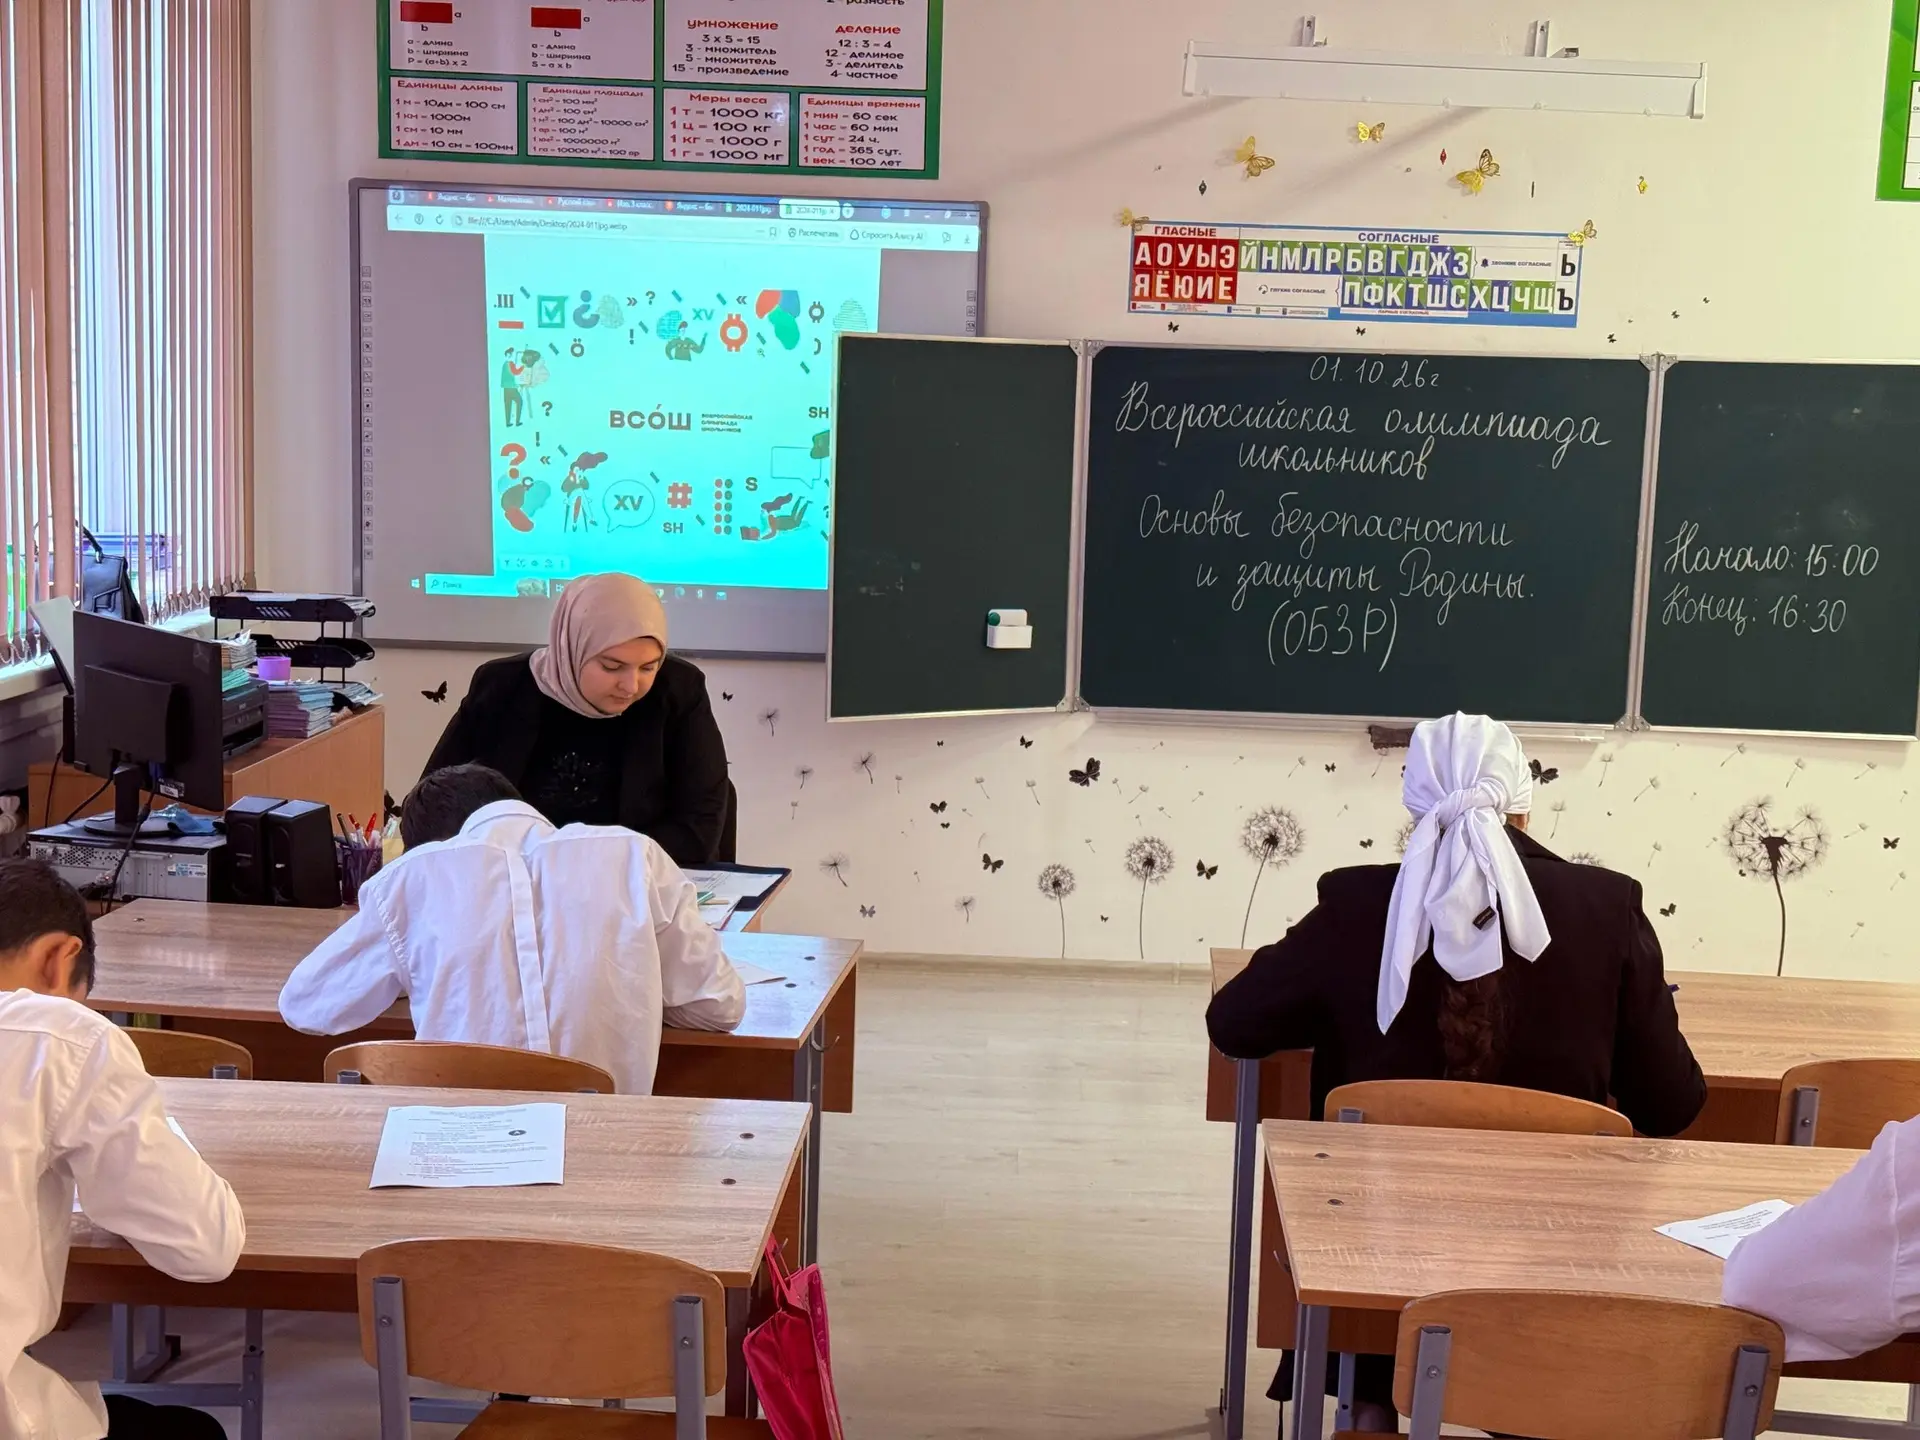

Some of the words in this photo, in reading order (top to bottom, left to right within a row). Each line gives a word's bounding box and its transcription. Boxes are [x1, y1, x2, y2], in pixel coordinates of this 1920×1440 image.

[687, 19, 779, 30] умножение
[835, 25, 901, 34] деление
[702, 34, 710, 42] 3
[725, 35, 733, 43] 5
[747, 36, 760, 44] 15
[838, 39, 852, 48] 12
[862, 40, 870, 48] 3
[883, 41, 892, 49] 4
[685, 44, 693, 52] 3
[705, 46, 777, 55] множитель
[825, 49, 838, 57] 12
[849, 51, 904, 60] делимое
[685, 54, 693, 62] 5
[705, 56, 777, 65] множитель
[825, 59, 833, 67] 3
[844, 61, 904, 70] делитель
[672, 64, 685, 72] 15
[697, 66, 789, 76] произведение
[846, 71, 898, 80] частное
[689, 93, 731, 104] Меры
[735, 95, 768, 104] веса
[807, 97, 864, 107] Единицы
[867, 100, 921, 108] времени
[465, 101, 489, 109] 100
[670, 106, 677, 115] 1
[710, 108, 759, 118] 1000
[764, 111, 783, 119] кг
[852, 112, 871, 120] 60
[430, 127, 444, 135] 10
[670, 120, 677, 129] 1
[682, 122, 694, 131] ц
[713, 122, 748, 132] 100
[850, 123, 869, 132] 60
[431, 140, 445, 149] 10
[670, 134, 677, 143] 1
[682, 136, 701, 144] кг
[720, 136, 769, 146] 1000
[812, 135, 835, 143] сут
[848, 135, 865, 143] 24
[670, 148, 677, 157] 1
[710, 150, 758, 160] 1000
[763, 153, 784, 161] мг
[849, 146, 874, 155] 365
[849, 158, 876, 166] 100
[1154, 226, 1217, 238] ГЛАСНЫЕ
[1358, 232, 1440, 244] СОГЛАСНЫЕ
[1115, 381, 1356, 448] Всероссийская
[1384, 405, 1612, 469] олимпиада
[1238, 436, 1435, 481] школьников
[745, 476, 758, 491] S
[613, 494, 644, 511] XV
[662, 522, 684, 534] SH
[1139, 489, 1250, 539] Основы
[1270, 491, 1515, 559] безопасности
[1804, 543, 1880, 577] 15:00
[1196, 563, 1218, 587] и
[1231, 559, 1381, 611] защиты
[1768, 594, 1847, 633] 16:30
